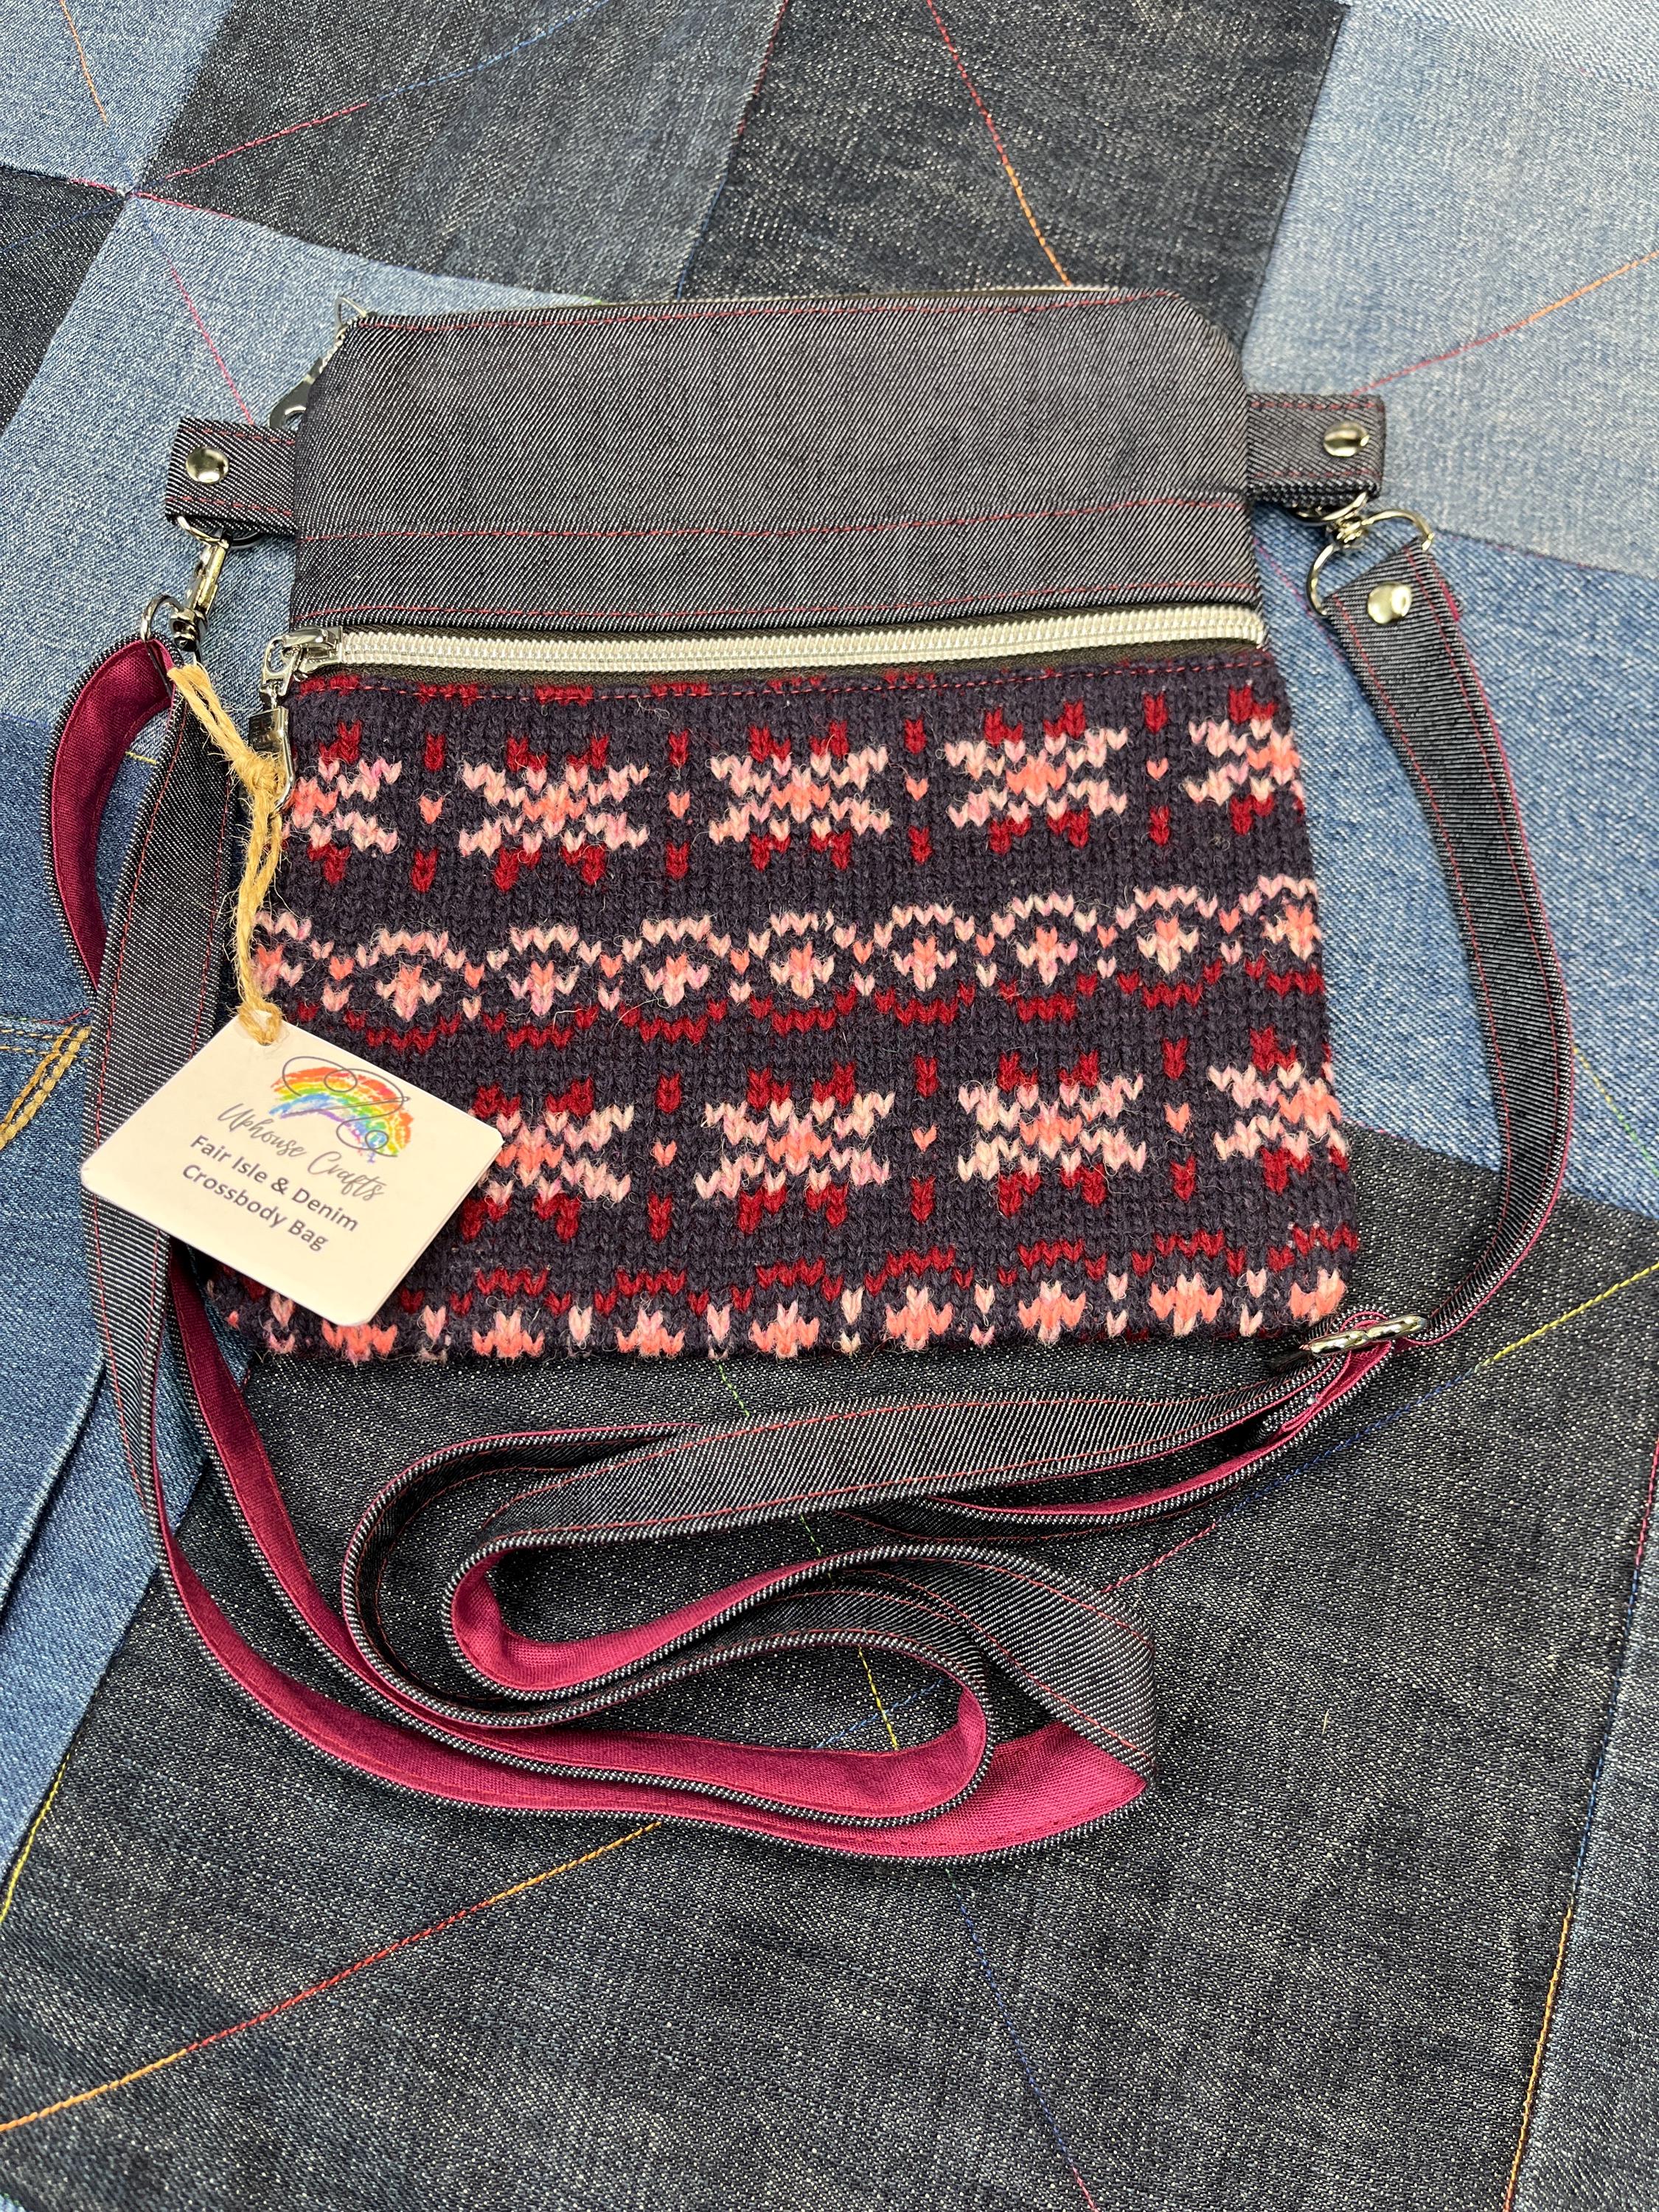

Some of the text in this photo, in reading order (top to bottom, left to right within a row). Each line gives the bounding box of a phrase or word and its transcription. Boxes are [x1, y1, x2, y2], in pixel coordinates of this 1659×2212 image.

[190, 1135, 358, 1232] Fair Isle & Denim
[218, 1103, 387, 1201] Uphouse Crafts
[183, 1164, 329, 1252] Crossbody Bag
